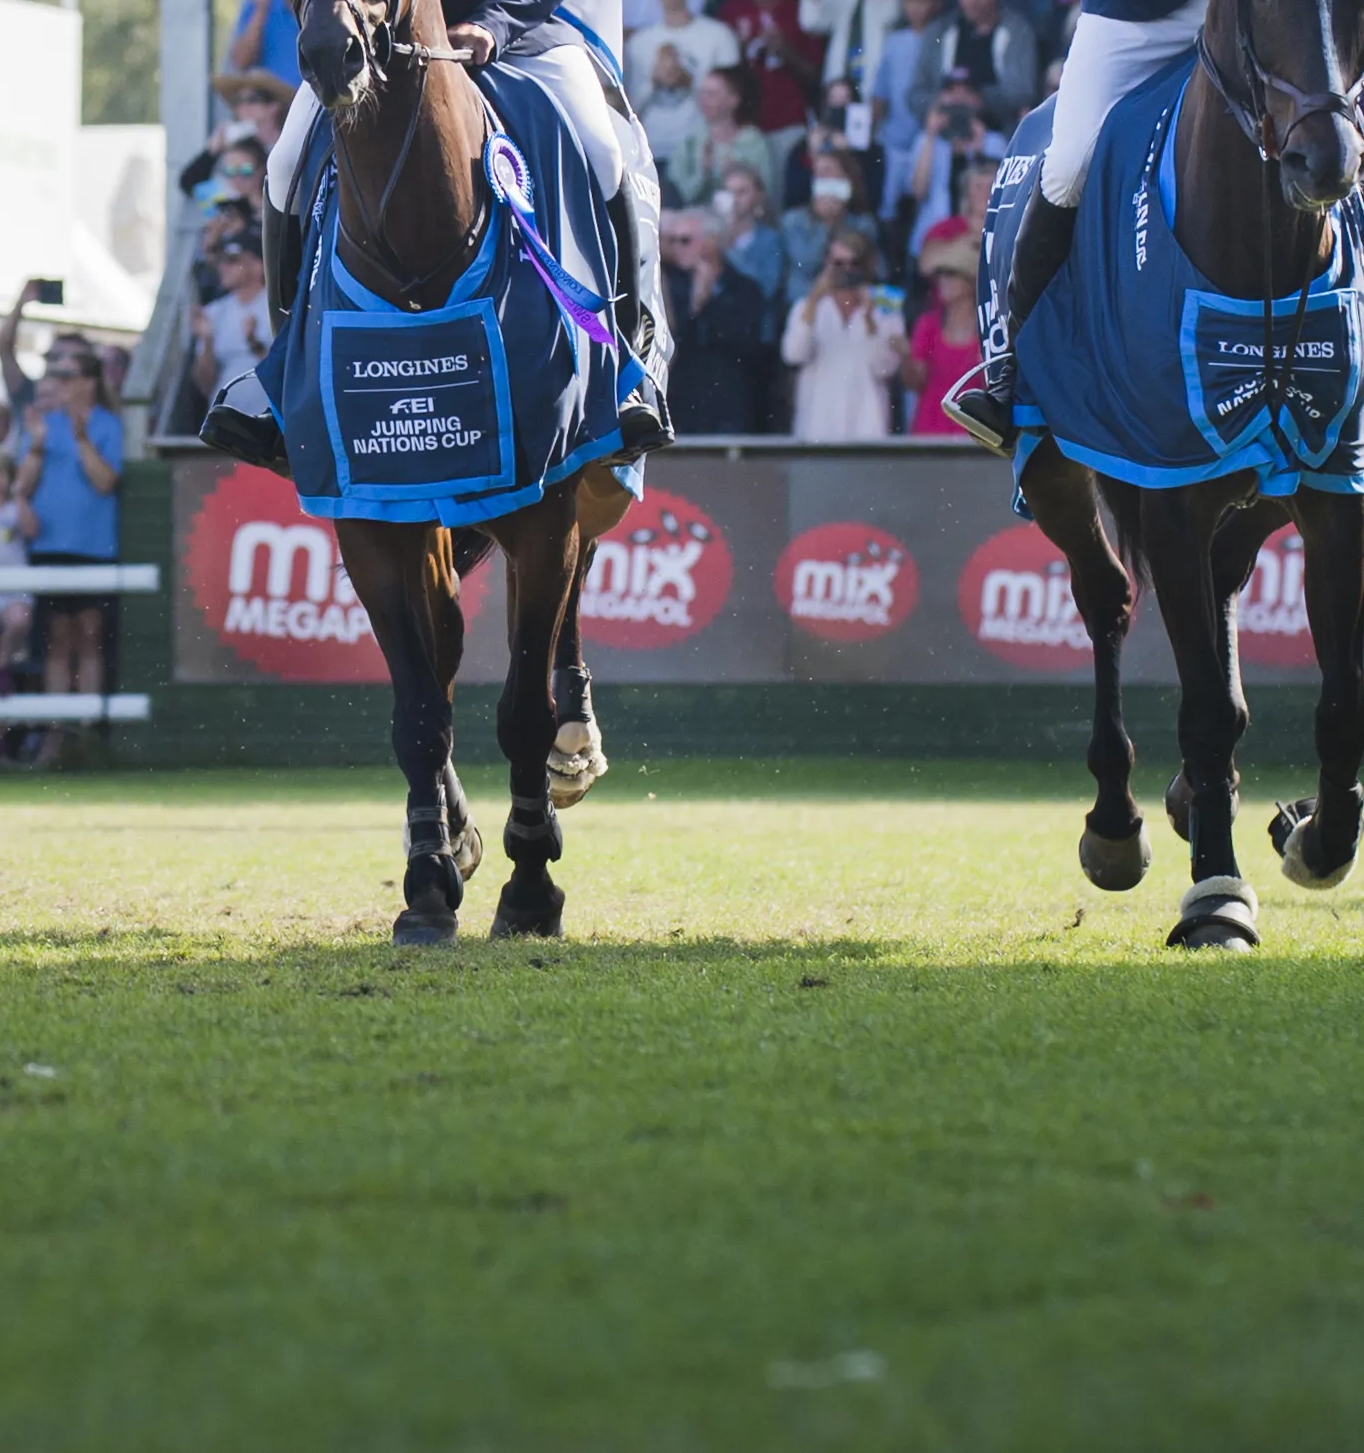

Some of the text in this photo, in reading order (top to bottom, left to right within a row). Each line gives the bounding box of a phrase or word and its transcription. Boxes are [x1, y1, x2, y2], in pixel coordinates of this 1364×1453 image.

[353, 354, 469, 378] LONGINES
[389, 397, 435, 414] FEI
[370, 416, 461, 437] JUMPING
[353, 430, 481, 454] NATIONS CUP
[229, 521, 357, 604] mi
[793, 552, 899, 604] mix
[224, 595, 372, 644] MEGAP
[978, 618, 1094, 650] MEGAPO
